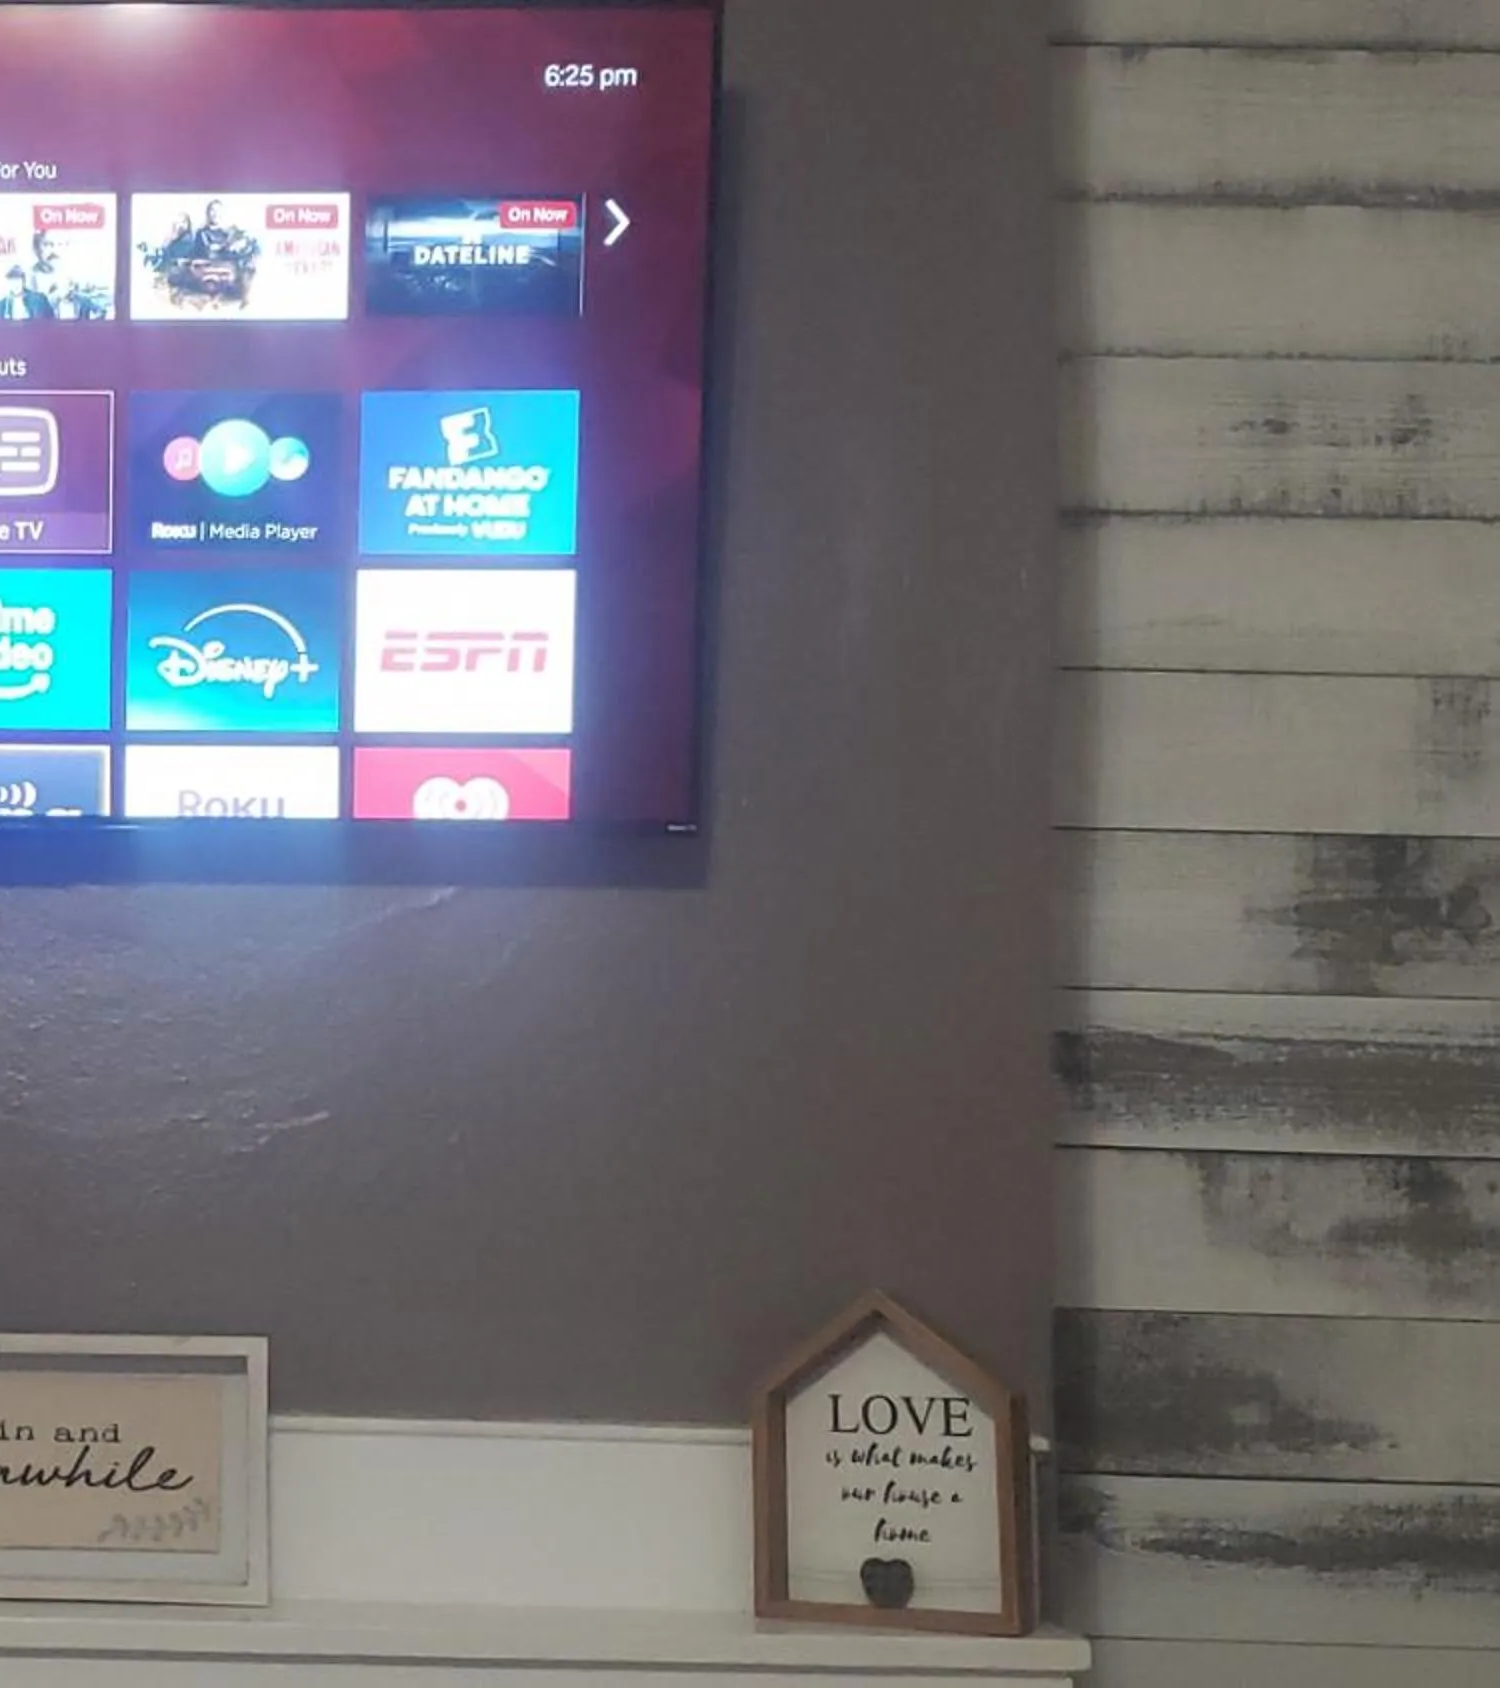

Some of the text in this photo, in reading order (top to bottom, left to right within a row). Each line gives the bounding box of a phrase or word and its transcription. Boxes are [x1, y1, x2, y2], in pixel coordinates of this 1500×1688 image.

[544, 63, 637, 91] 6:25 pm
[23, 161, 57, 179] You
[40, 207, 99, 223] On Now
[273, 208, 330, 223] On Now
[507, 207, 568, 222] On Now
[414, 245, 530, 265] DATELINE
[388, 466, 550, 490] FANDANGO
[405, 493, 531, 517] AT HOME
[14, 521, 45, 541] TV
[209, 523, 260, 539] Media
[265, 523, 318, 542] Player
[380, 631, 549, 672] ESPN
[828, 1394, 974, 1437] LOVE
[54, 1423, 122, 1444] and
[826, 1442, 978, 1472] is what makes
[842, 1480, 963, 1508] our house a
[874, 1518, 932, 1543] home
